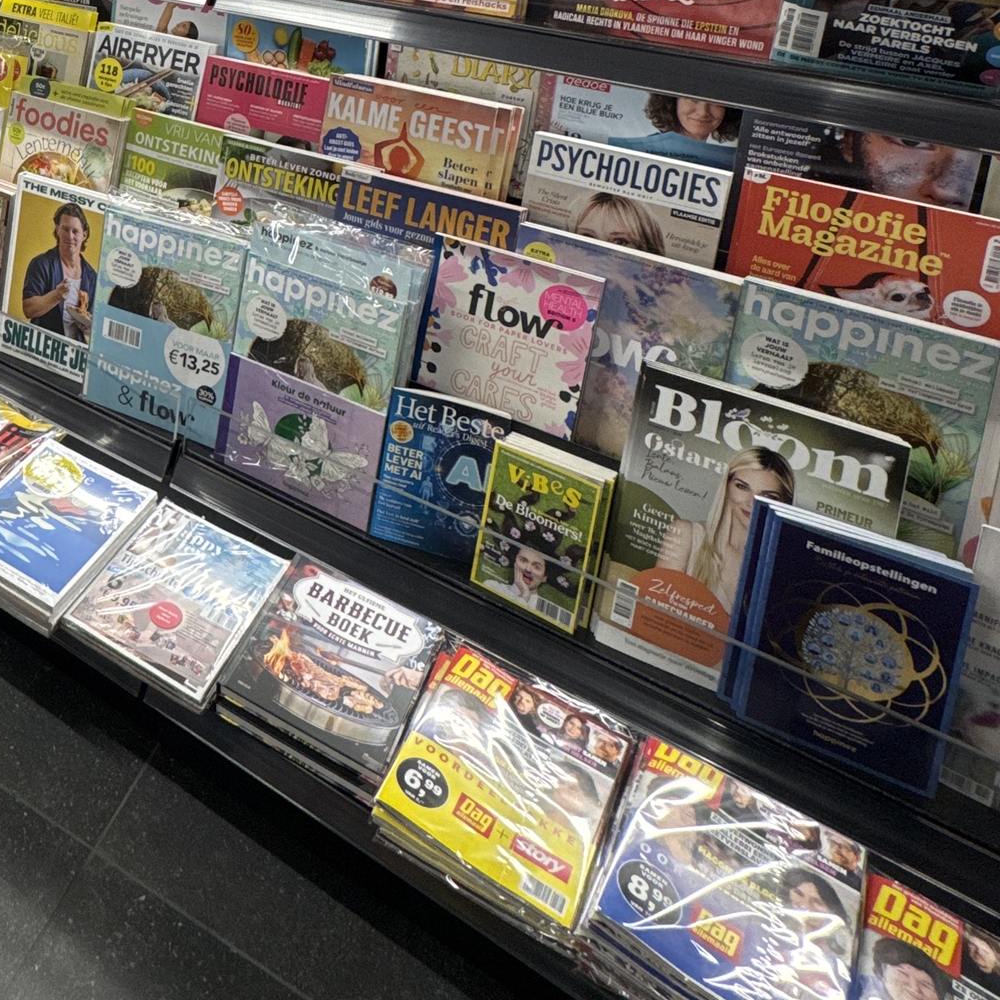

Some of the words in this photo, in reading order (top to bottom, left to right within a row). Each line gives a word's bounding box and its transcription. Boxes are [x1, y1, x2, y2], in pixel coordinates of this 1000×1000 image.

[12, 2, 37, 17] EXTRA
[38, 4, 54, 19] VEEL
[859, 13, 955, 36] ZOEKTOCHT
[554, 11, 585, 23] RADICAAL
[586, 16, 612, 28] RECHTS
[613, 20, 621, 29] IN
[623, 22, 669, 37] VLAANDEREN
[671, 30, 683, 38] OM
[685, 32, 707, 42] HAAR
[708, 35, 737, 47] VINGER
[739, 39, 764, 51] WOND
[833, 19, 875, 34] NAAR
[881, 27, 978, 52] VERBORGEN
[871, 37, 931, 54] PARELS
[98, 35, 200, 76] AIRFRYER
[100, 64, 119, 76] 118
[209, 64, 309, 104] PSYCHOLOGIE
[15, 98, 109, 147] foodies
[327, 92, 402, 133] KALME
[131, 154, 156, 176] 100
[250, 154, 274, 166] BETER
[277, 158, 303, 172] LEVEN
[438, 170, 478, 189] slapen
[442, 157, 478, 174] Beter
[536, 139, 722, 207] PSYCHOLOGIES
[23, 180, 48, 192] THE
[50, 187, 96, 207] MESSY
[343, 181, 401, 221] LEEF
[405, 200, 511, 250] LANGER
[761, 185, 928, 245] Filosofie
[105, 214, 240, 272] happinez
[757, 210, 944, 277] Magazine
[469, 283, 563, 339] flow
[2, 322, 69, 363] SNELLERE
[459, 322, 548, 373] CRAFT
[742, 281, 999, 383] happinez
[168, 350, 221, 376] €13,25
[271, 378, 296, 395] Kleur
[298, 391, 311, 401] de
[450, 368, 537, 422] CARES
[395, 395, 436, 423] Het
[441, 406, 505, 440] Beste
[386, 453, 423, 470] LEVEN
[388, 444, 424, 460] BETER
[496, 493, 513, 512] De
[515, 501, 583, 541] Bloomers!
[632, 510, 682, 535] Kimpen
[642, 503, 674, 524] Geert
[816, 501, 873, 529] PRIMEUR
[806, 540, 938, 595] Familieopstellingen
[307, 582, 412, 644] BARBECUE
[327, 610, 373, 645] BOEK
[459, 798, 495, 831] Dag
[515, 836, 566, 874] story
[867, 913, 942, 960] allemaal
[873, 883, 961, 967] Dag
